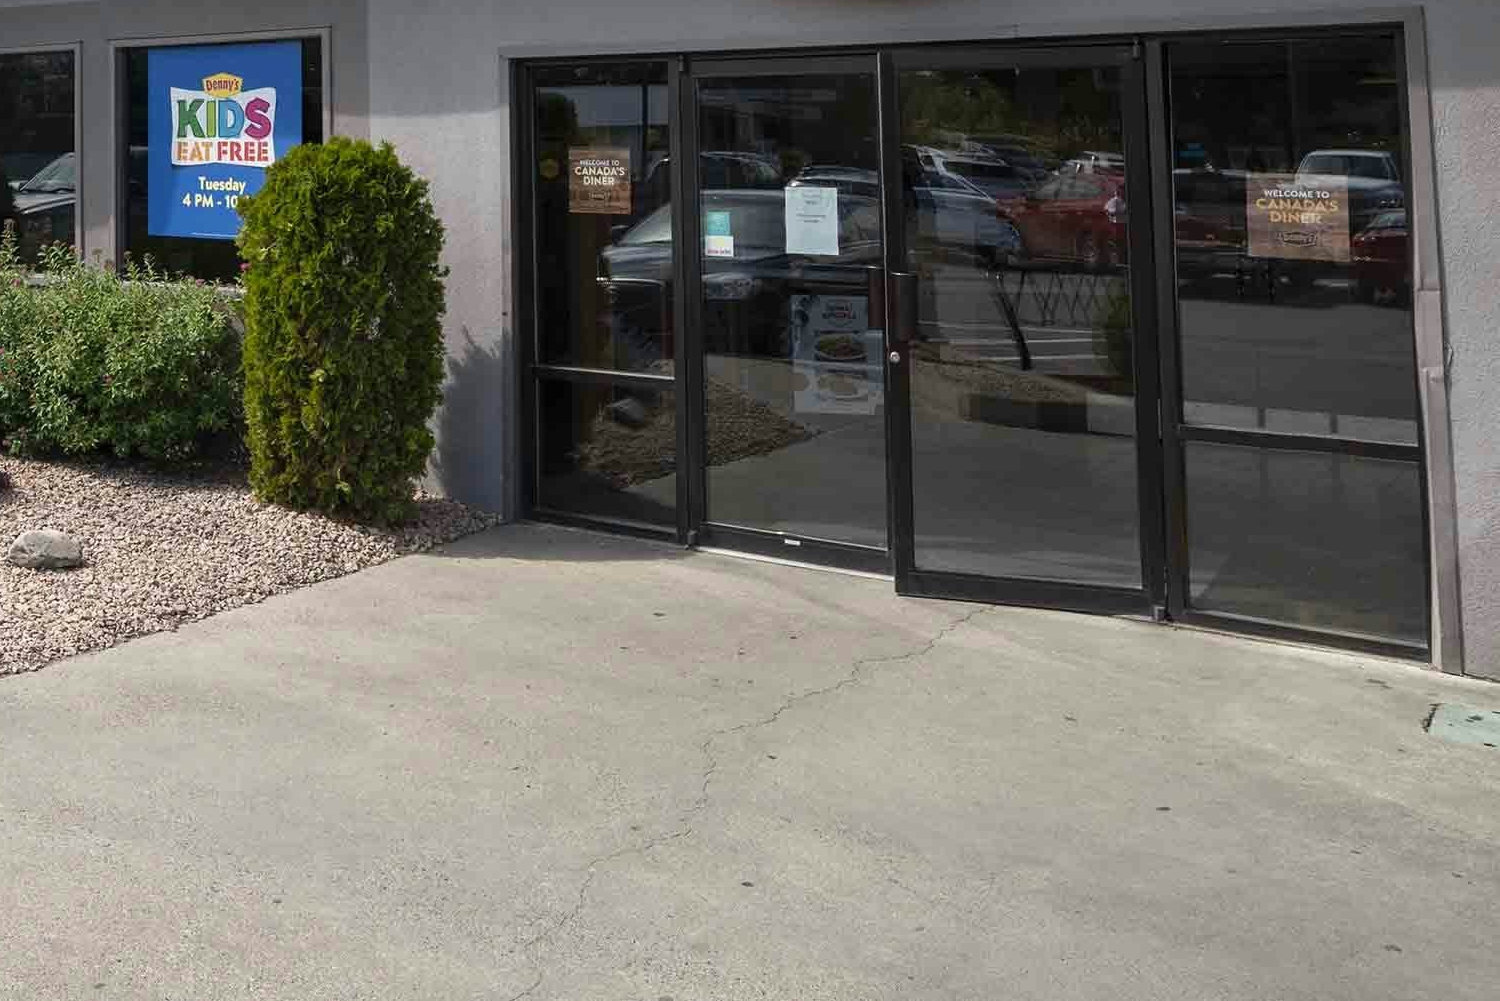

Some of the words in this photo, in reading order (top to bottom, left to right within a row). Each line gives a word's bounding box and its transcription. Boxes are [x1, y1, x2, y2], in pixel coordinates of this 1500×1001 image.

[206, 78, 239, 92] Denny's
[177, 97, 271, 140] KIDS
[177, 141, 213, 161] EAT
[217, 141, 268, 161] FREE
[574, 167, 625, 176] CANADA'S
[198, 176, 246, 194] Tuesday
[583, 176, 615, 185] DINER
[182, 193, 191, 207] 4
[195, 195, 214, 207] PM
[225, 195, 238, 208] 10
[1264, 190, 1313, 199] WELCOME
[1316, 190, 1330, 199] TO
[1256, 198, 1339, 212] CANADA'S
[1269, 210, 1322, 224] DINER
